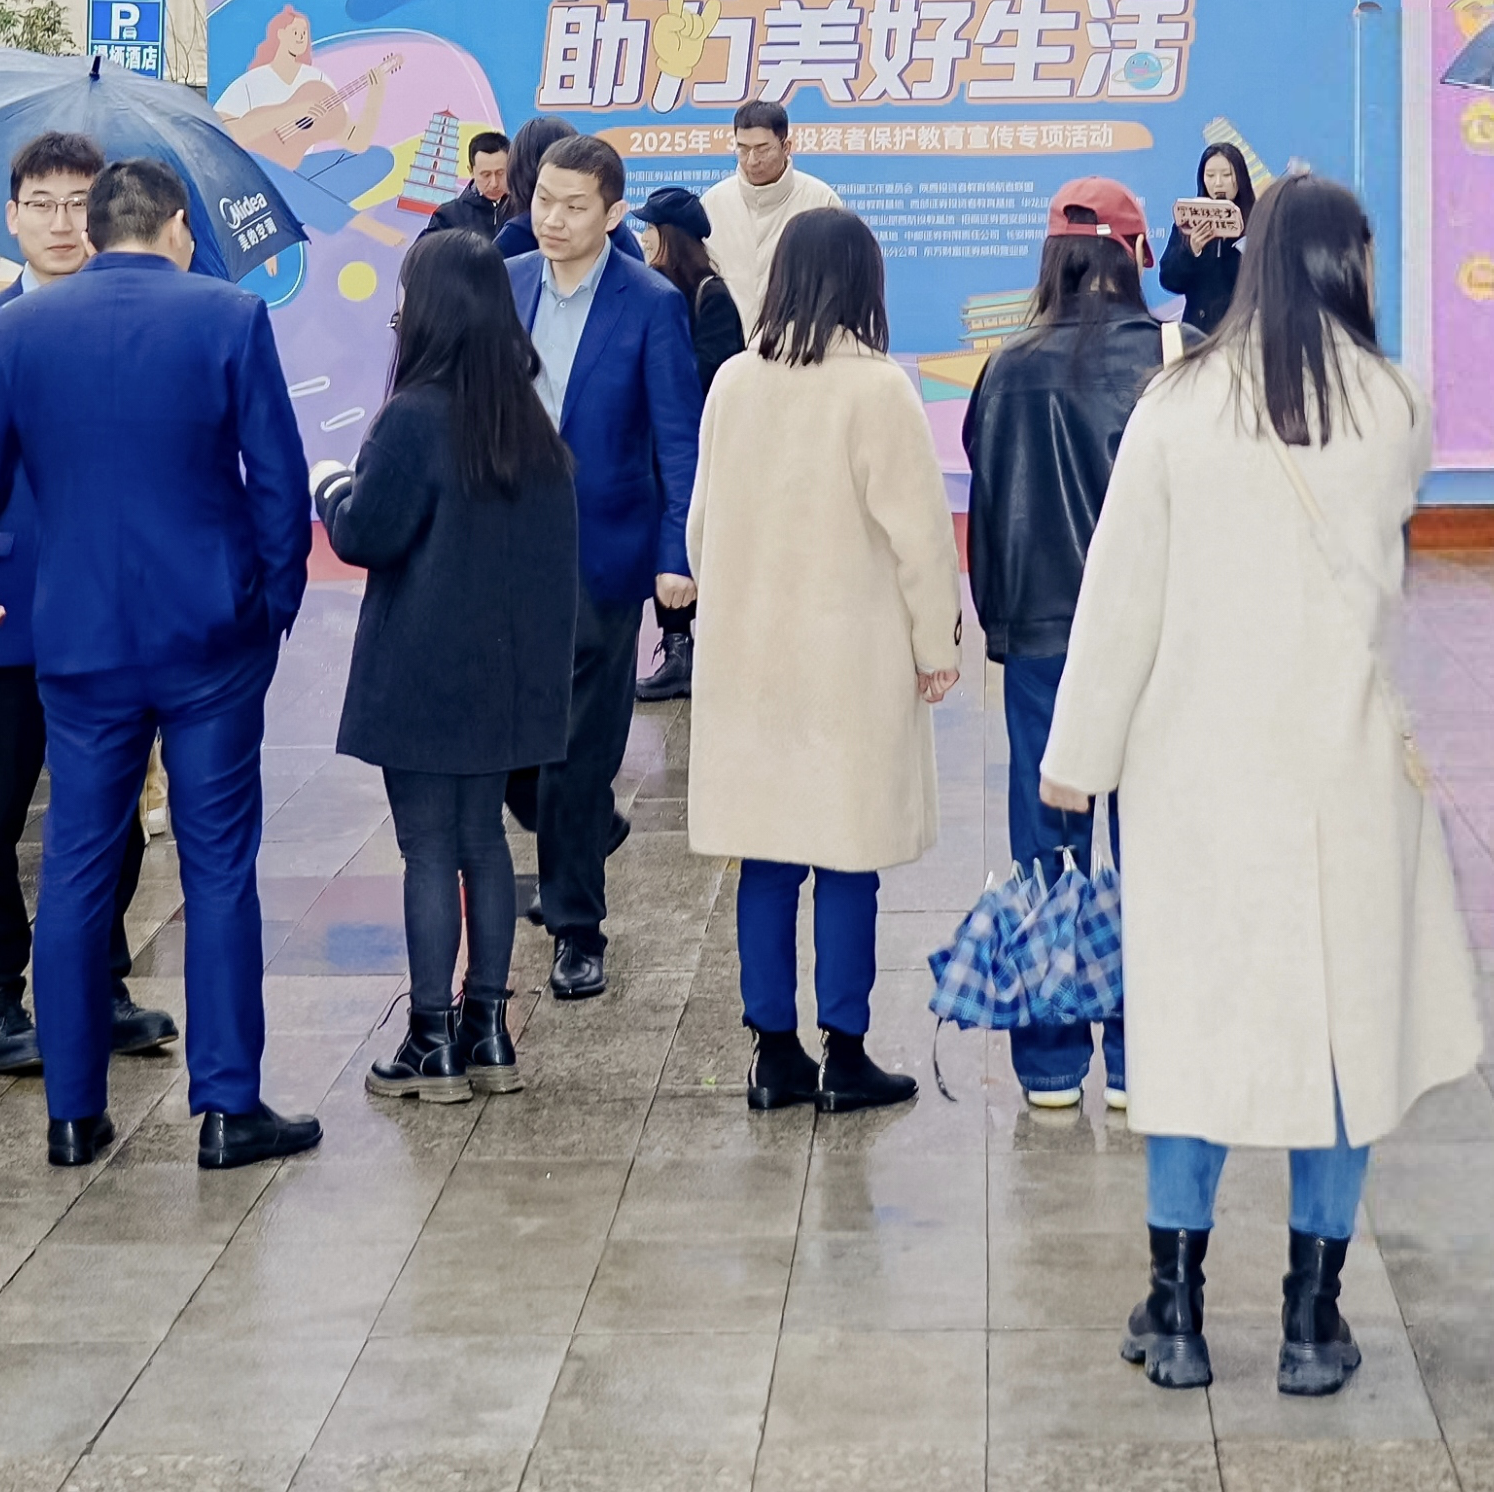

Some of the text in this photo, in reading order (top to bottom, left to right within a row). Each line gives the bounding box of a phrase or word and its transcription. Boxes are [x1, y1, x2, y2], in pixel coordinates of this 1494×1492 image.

[111, 2, 140, 40] P
[219, 192, 268, 230] Midea
[237, 216, 278, 253] 美的空调
